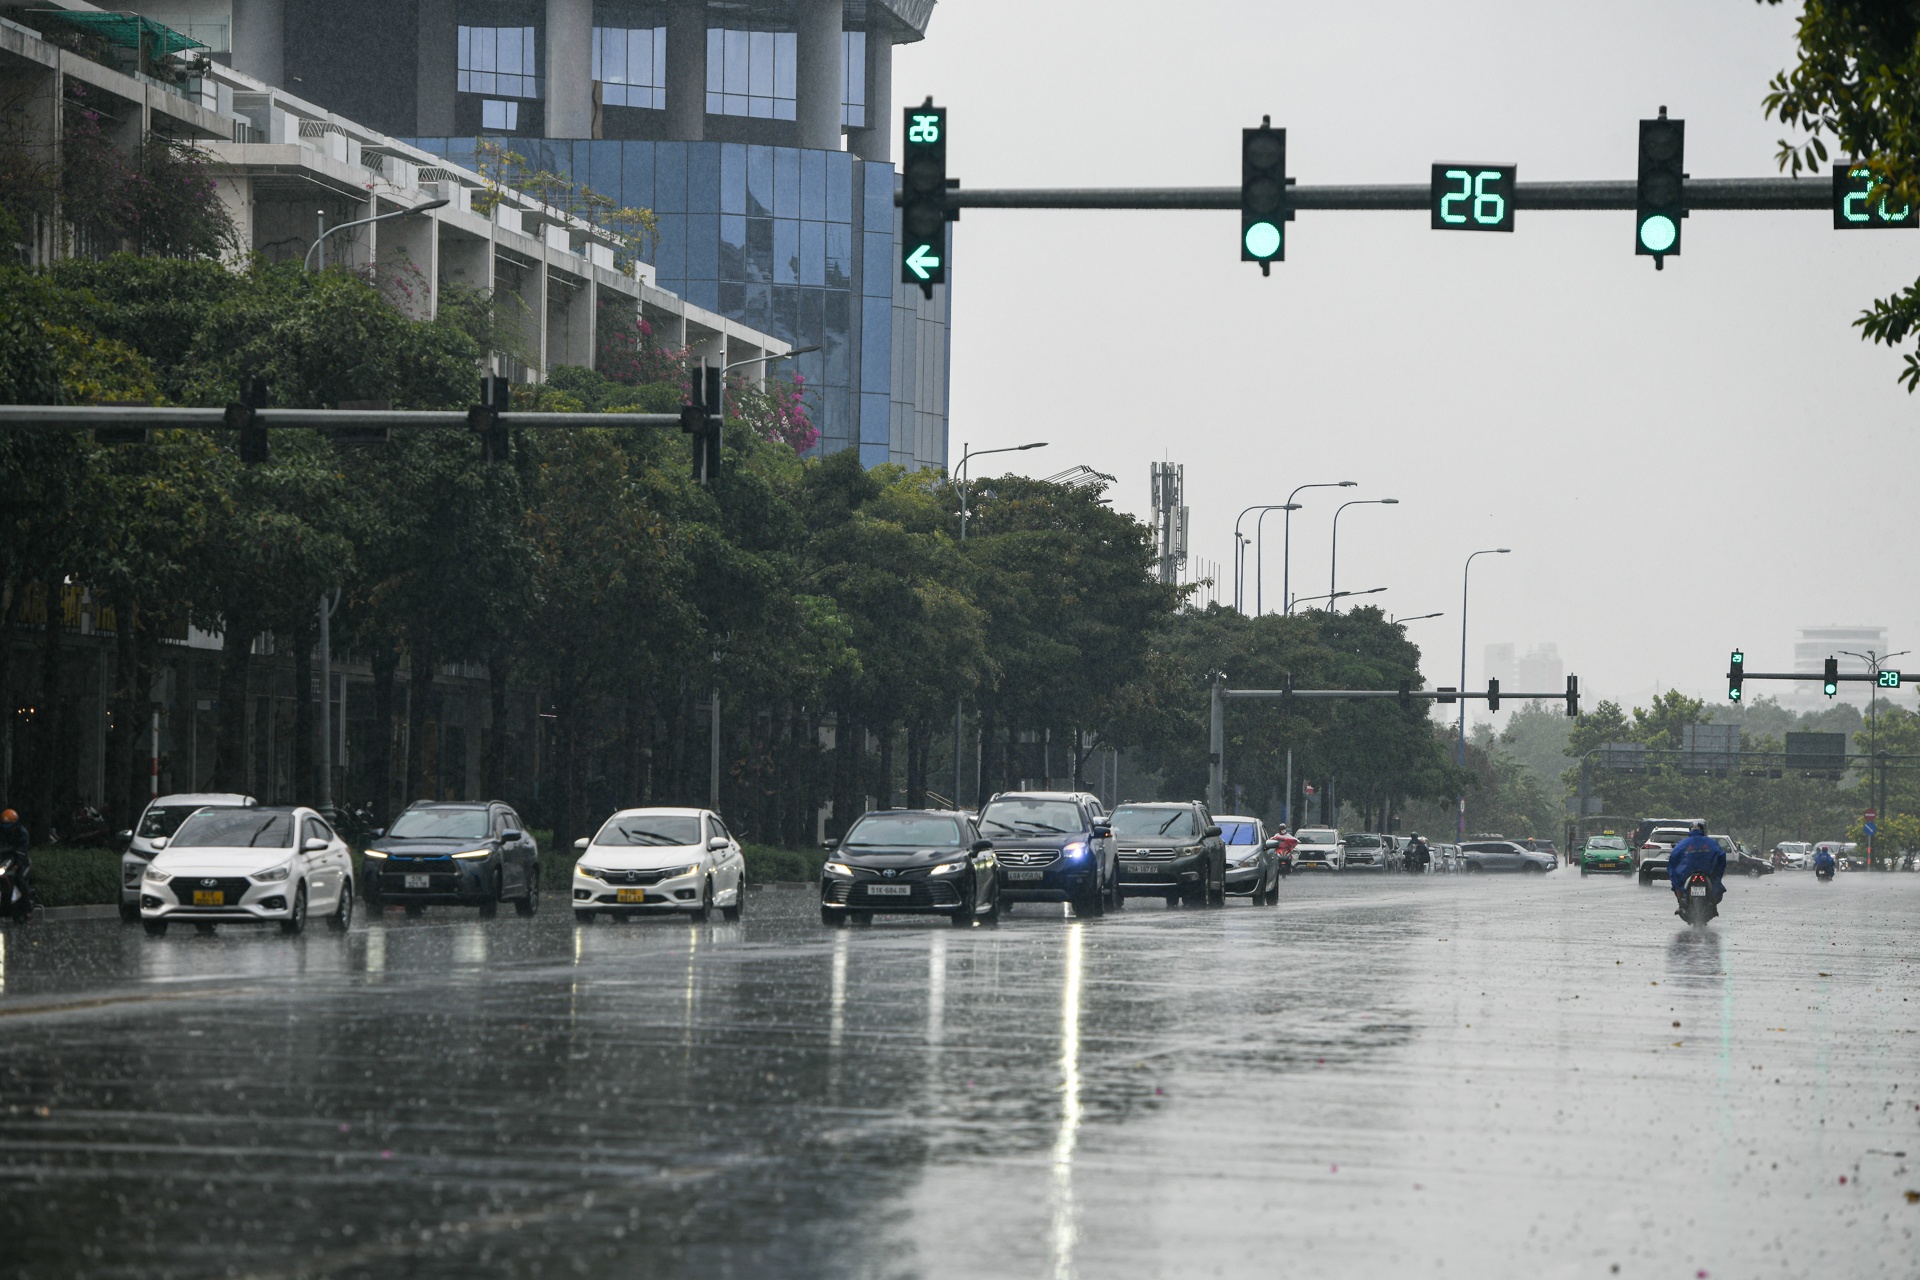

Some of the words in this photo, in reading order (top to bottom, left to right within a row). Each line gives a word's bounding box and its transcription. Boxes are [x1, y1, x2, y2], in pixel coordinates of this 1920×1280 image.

[909, 115, 938, 142] 26
[1441, 170, 1504, 224] 26
[1879, 671, 1898, 686] 28
